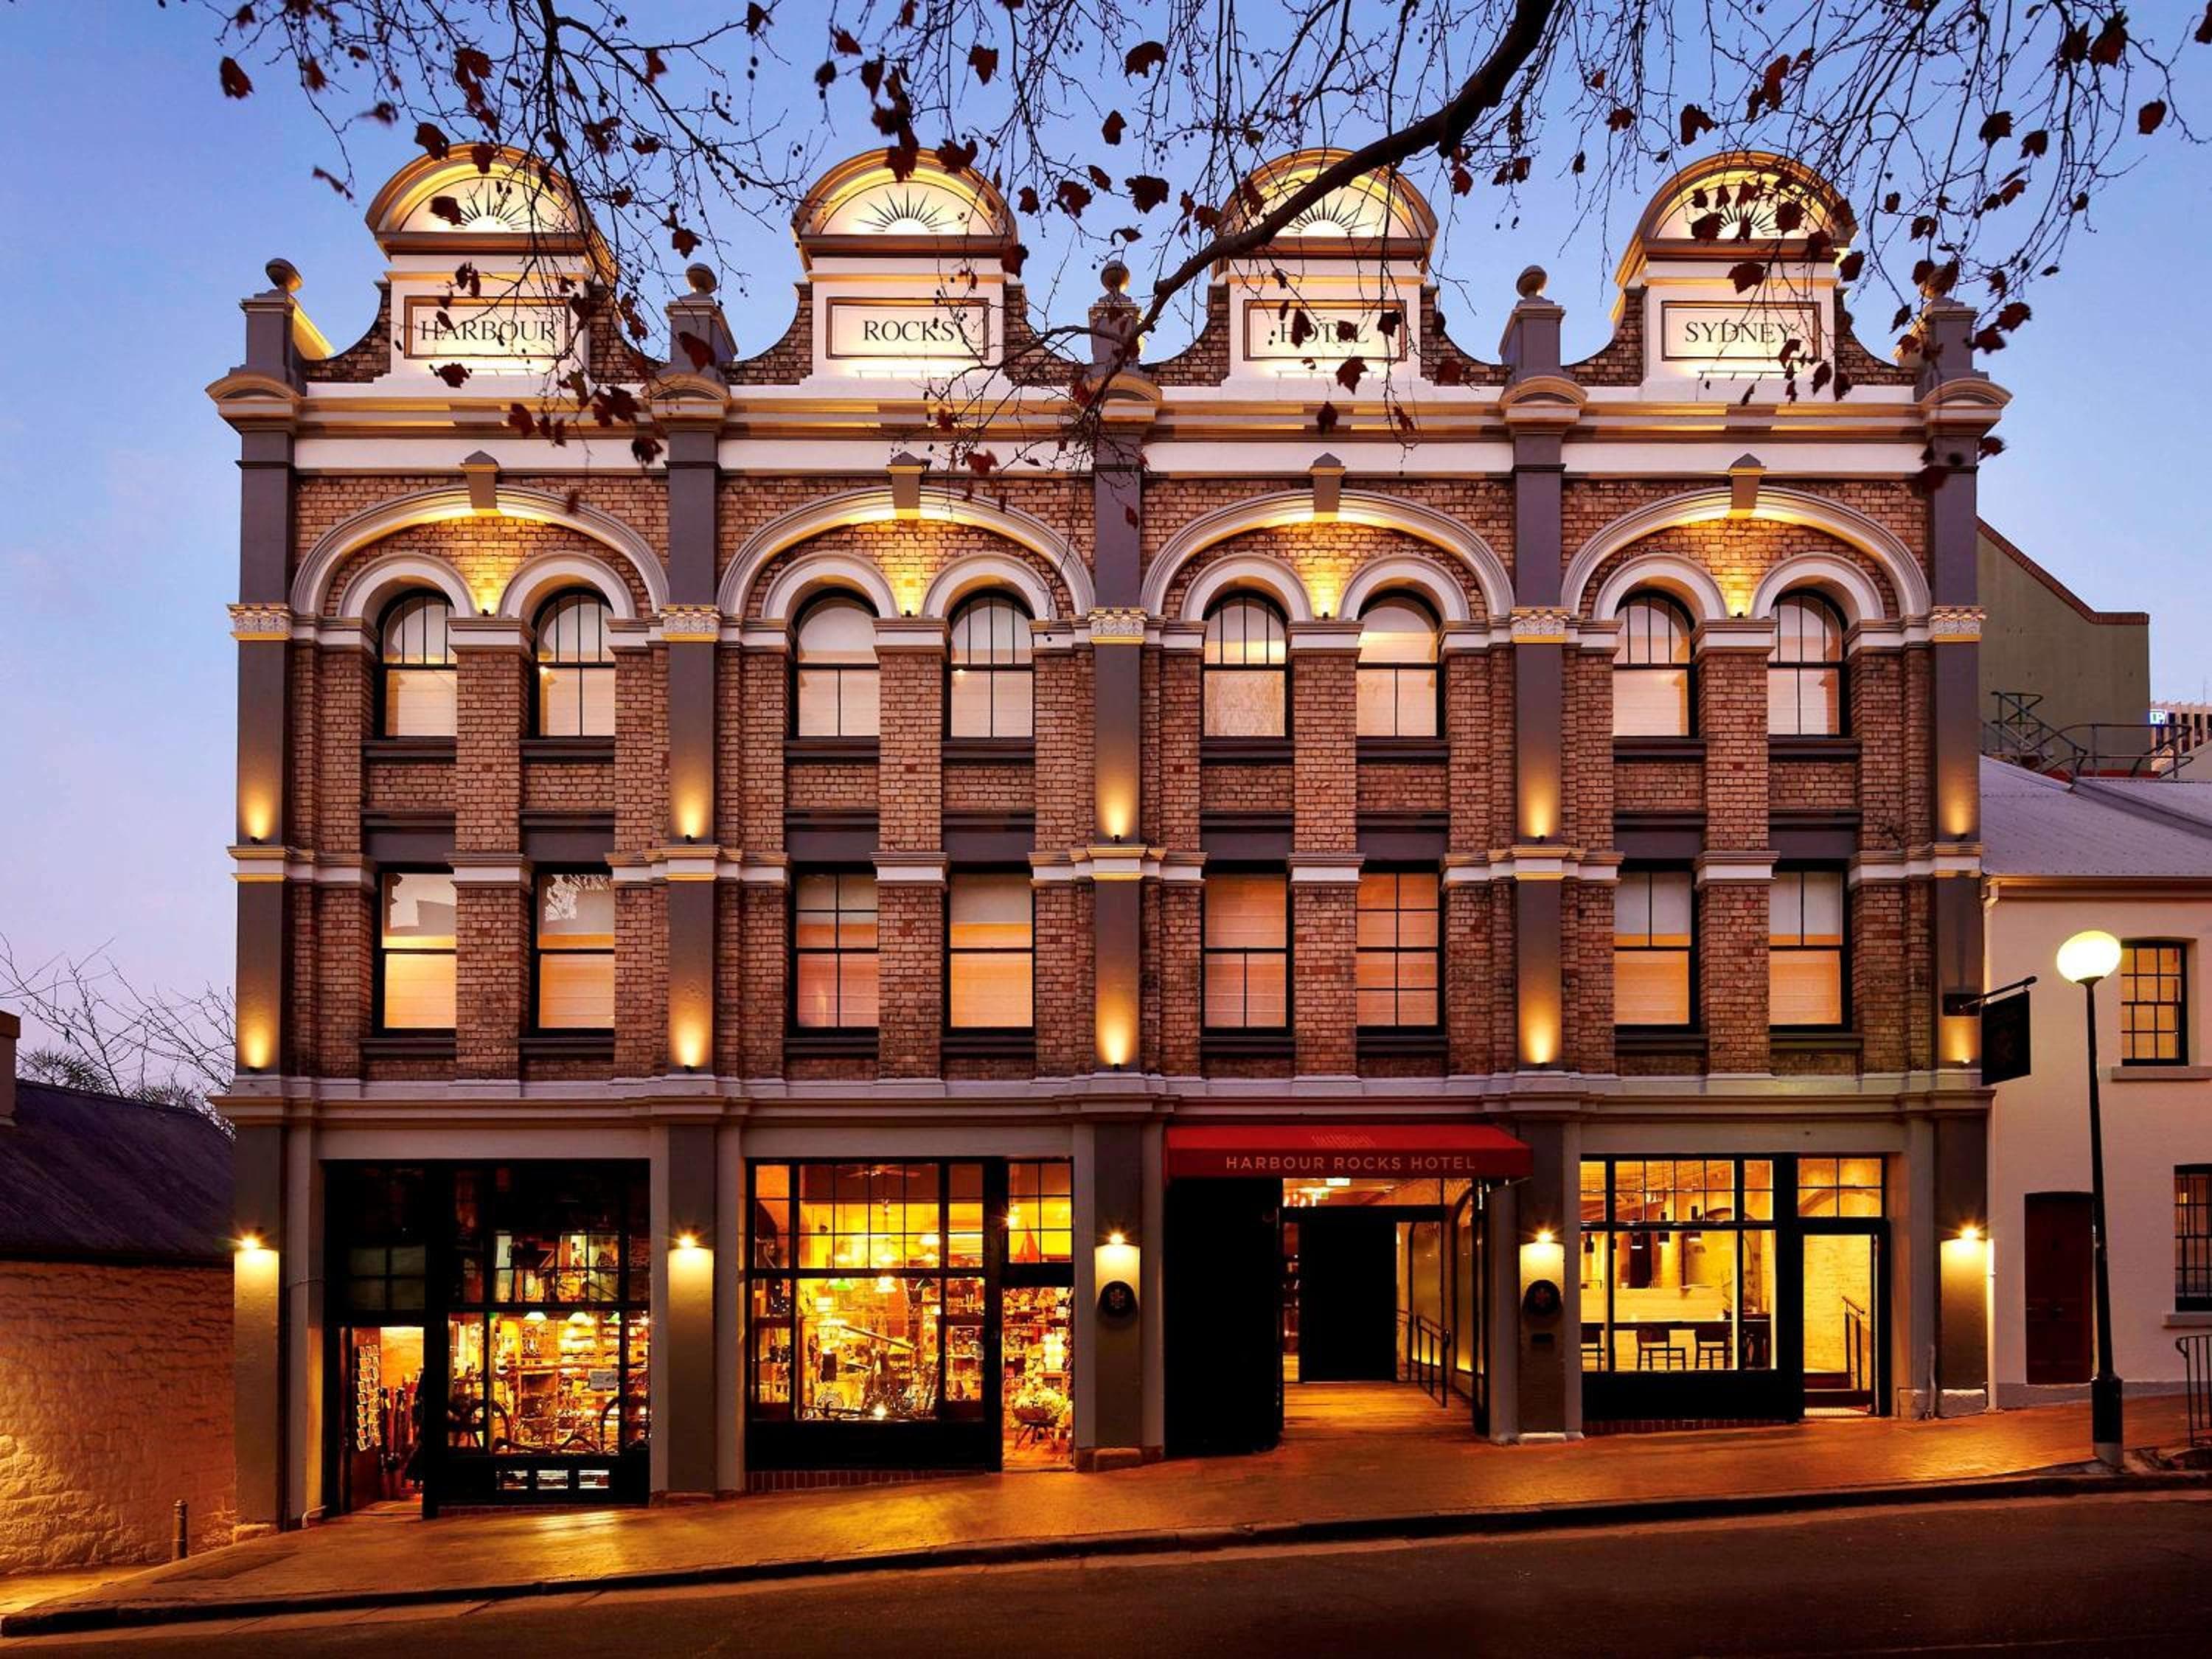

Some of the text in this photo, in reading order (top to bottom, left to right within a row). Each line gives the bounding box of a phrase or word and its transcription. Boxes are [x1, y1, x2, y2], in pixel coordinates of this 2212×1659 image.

[421, 320, 556, 341] HARBOUR
[863, 320, 954, 341] ROCKS
[1280, 322, 1369, 343] HOTL
[1685, 321, 1793, 342] SYDNEY
[1226, 1156, 1475, 1169] HARBOUR ROCKS HOTEL
